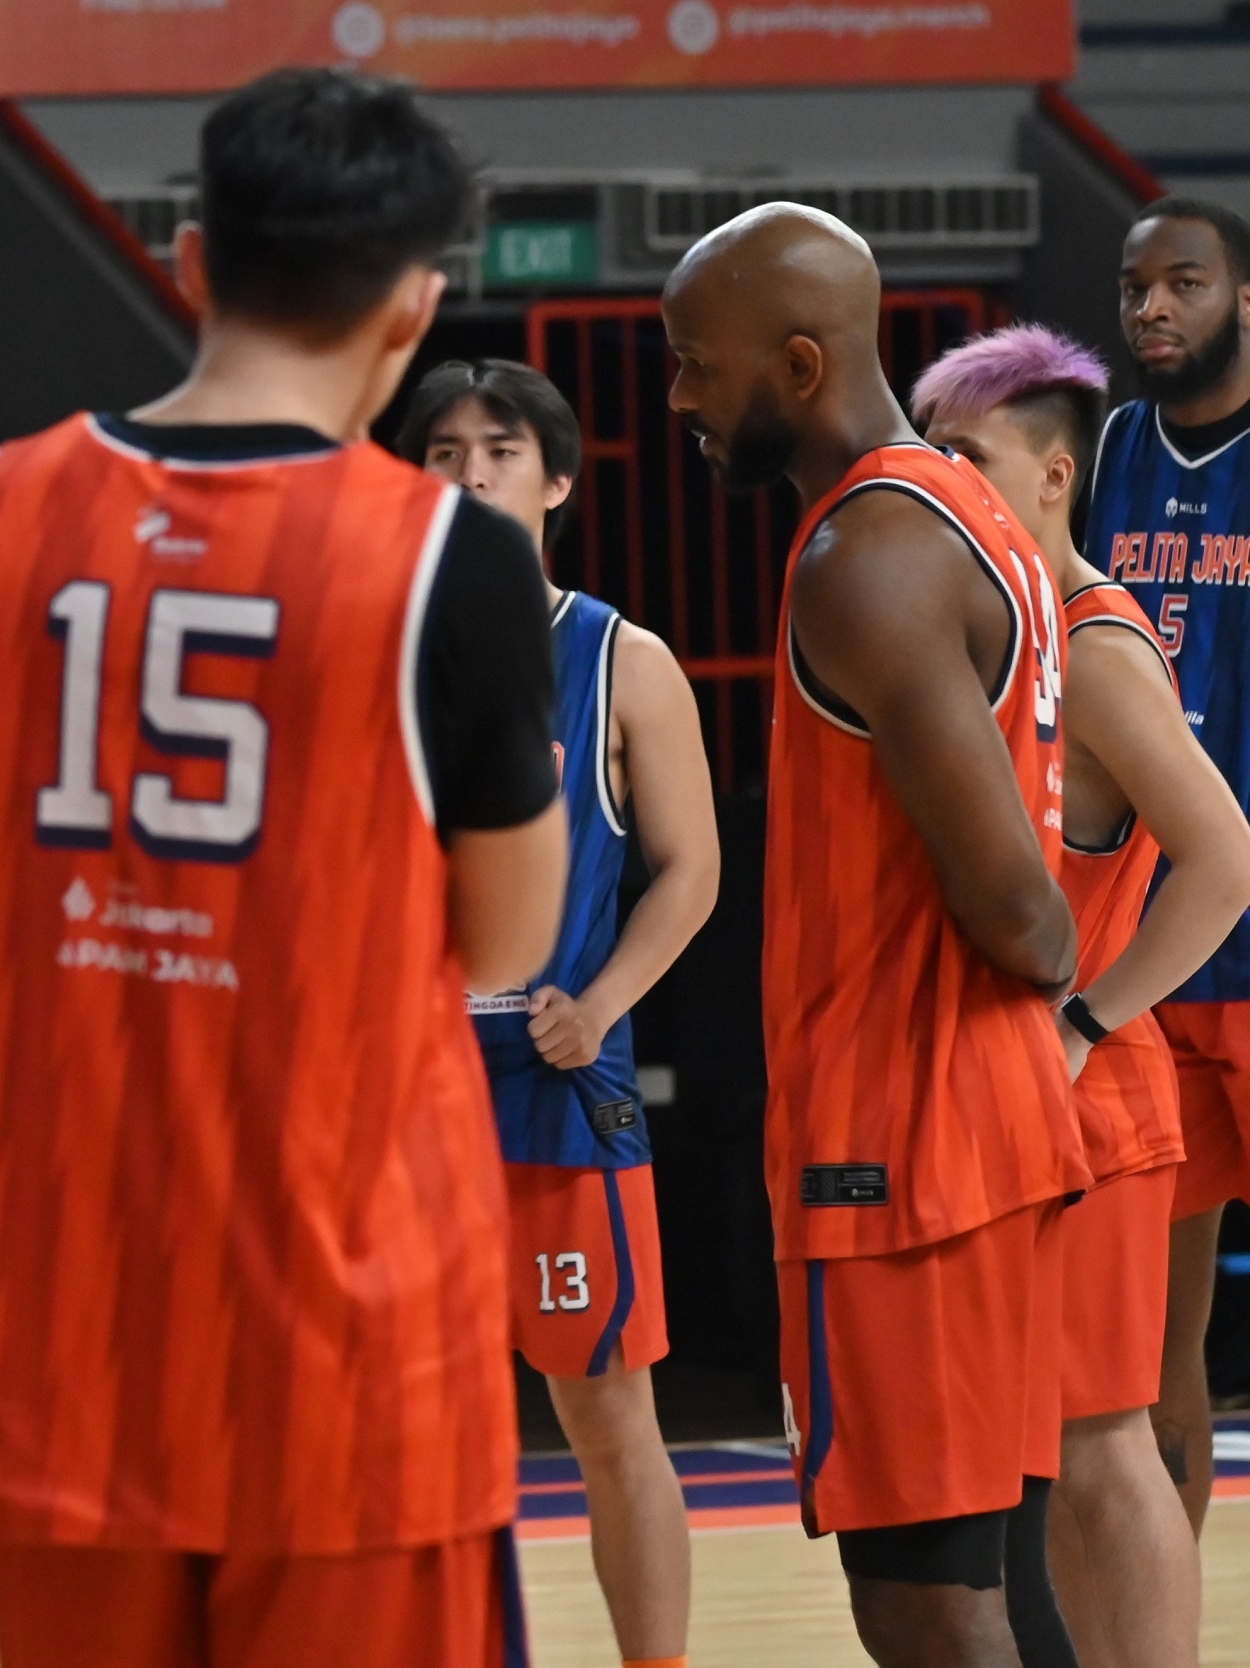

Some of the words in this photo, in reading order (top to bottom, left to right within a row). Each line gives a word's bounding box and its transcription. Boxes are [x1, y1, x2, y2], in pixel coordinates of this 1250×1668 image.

[499, 229, 572, 277] EXIT
[1179, 502, 1208, 514] MILLS
[1108, 532, 1189, 584] PELITA
[1158, 594, 1189, 658] 5
[36, 578, 279, 863] 15
[535, 1252, 590, 1314] 13
